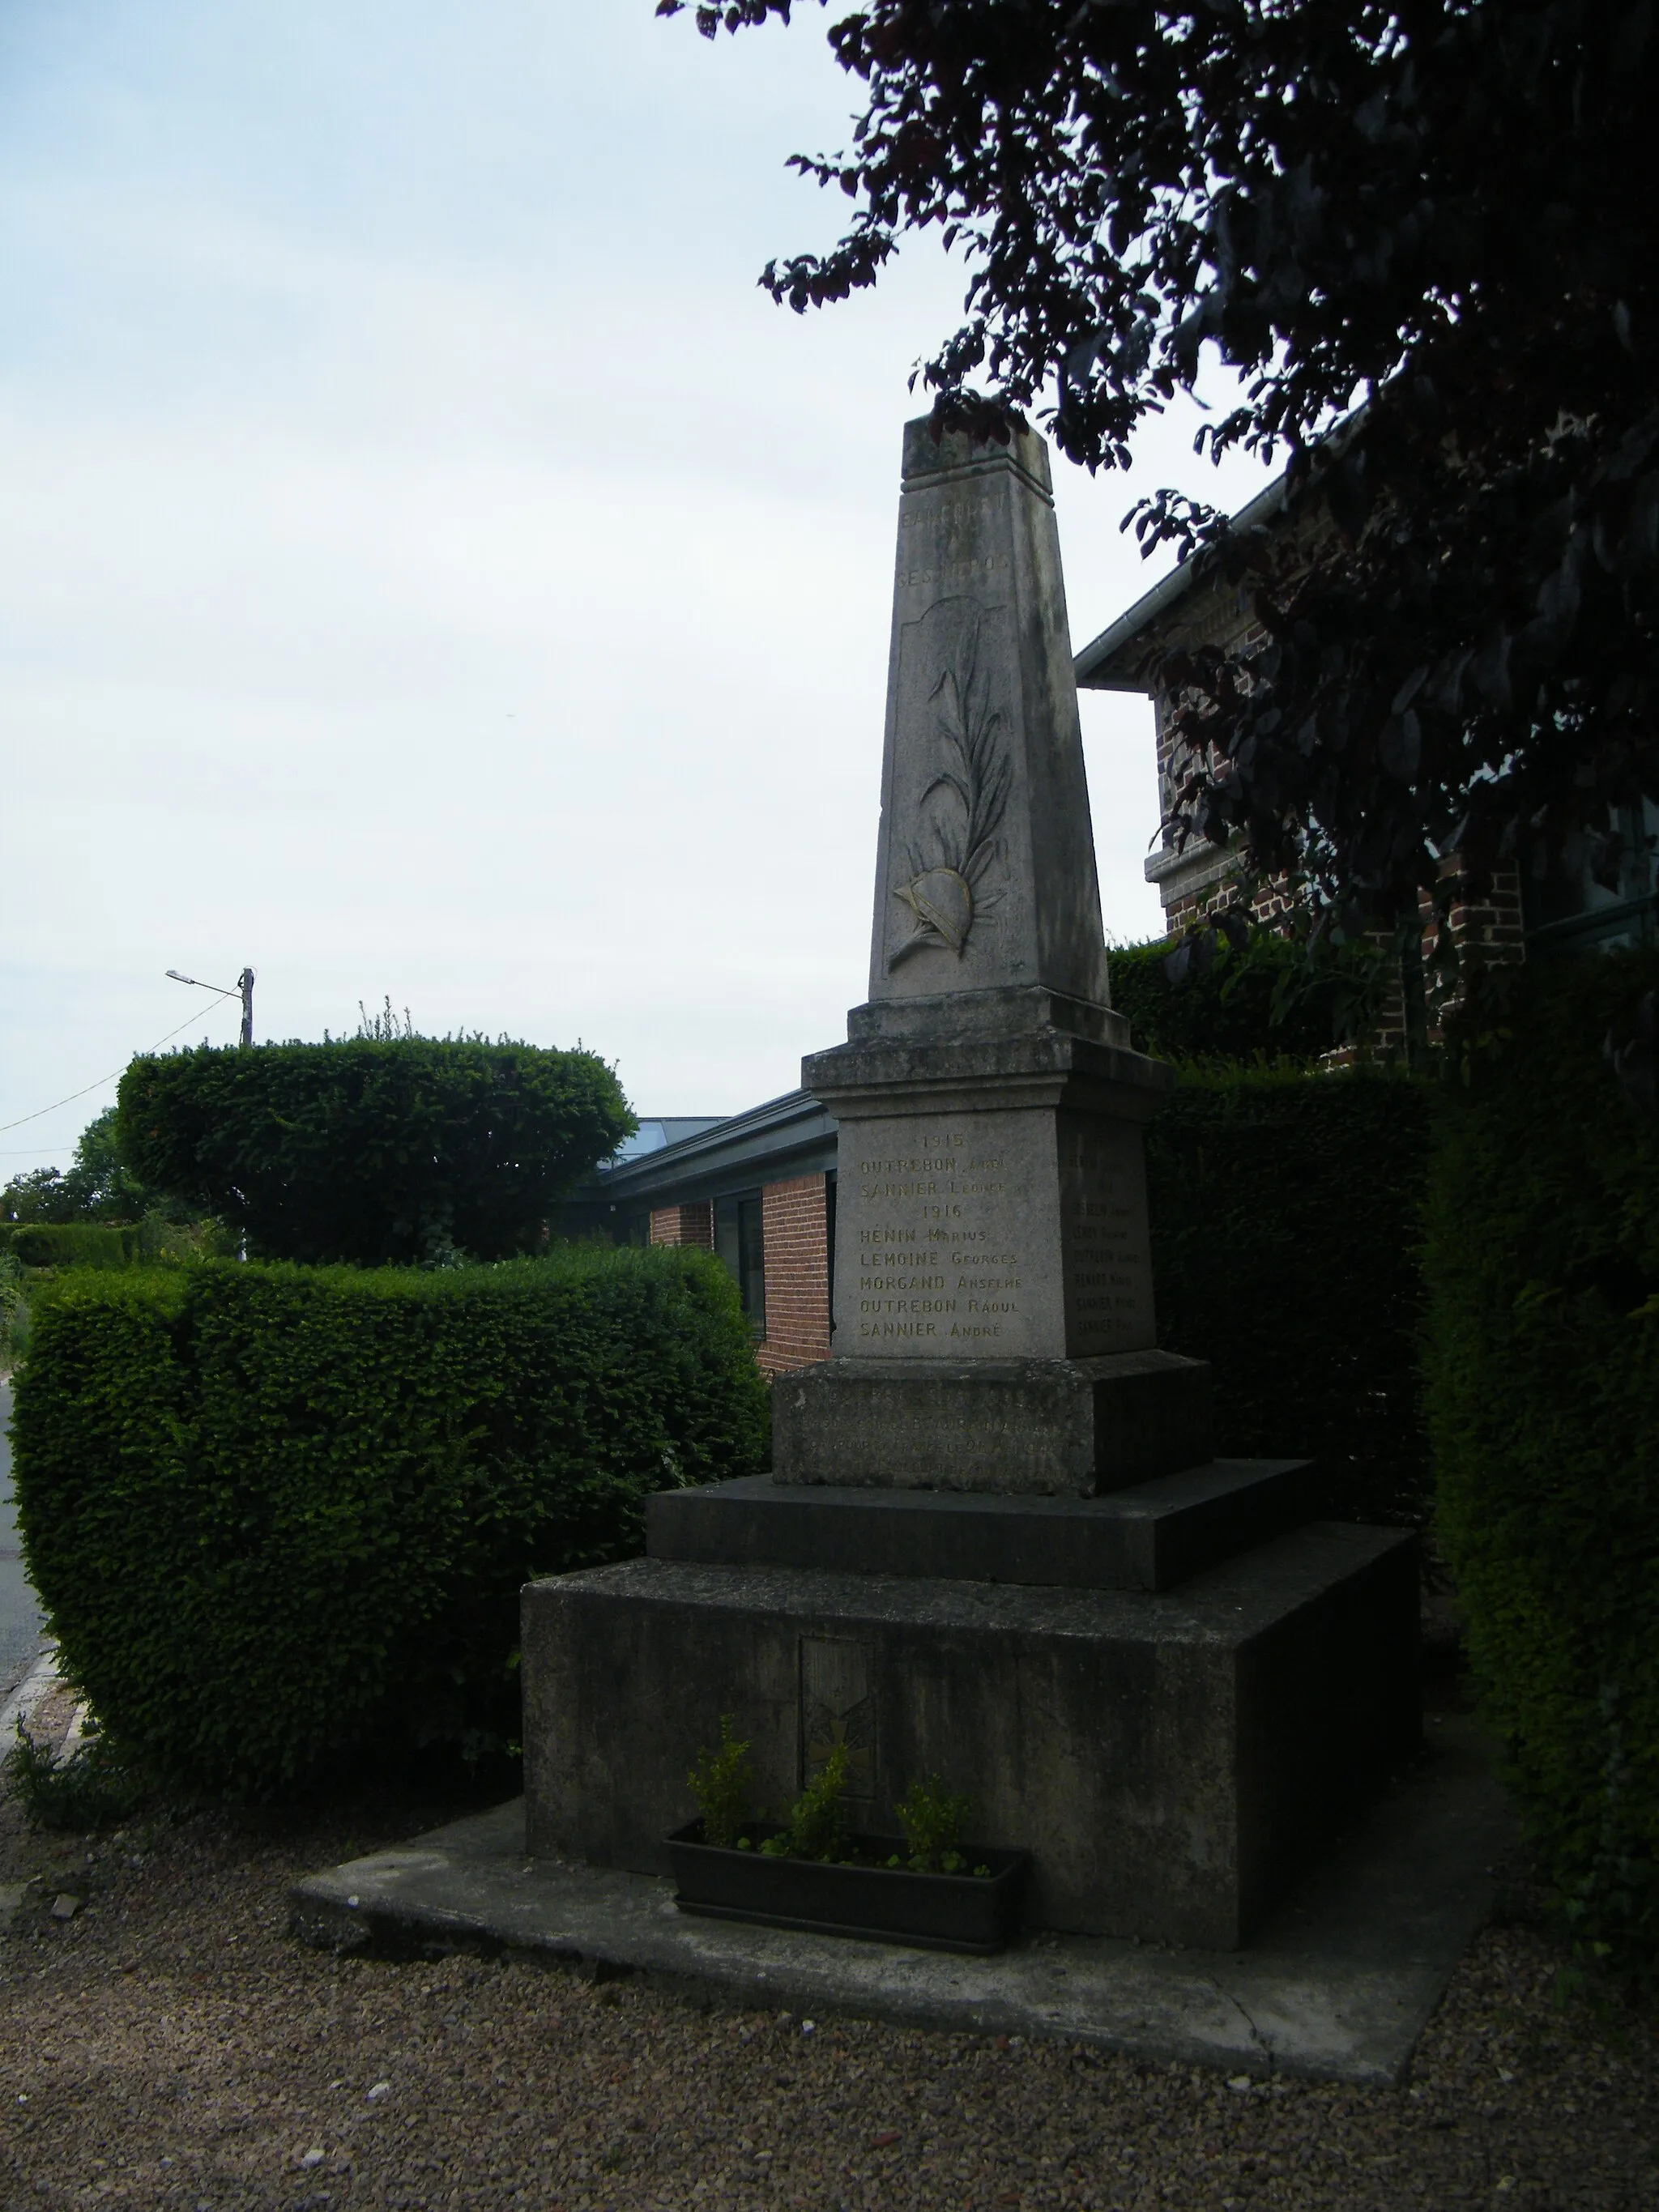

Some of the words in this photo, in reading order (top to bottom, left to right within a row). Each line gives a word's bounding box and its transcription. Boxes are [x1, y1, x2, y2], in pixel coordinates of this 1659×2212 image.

[923, 1134, 963, 1149] 1915
[861, 1157, 956, 1174] OUTREBON
[861, 1182, 937, 1200] SANNIER
[923, 1204, 962, 1219] 1916
[860, 1251, 939, 1267] LEMOINE
[859, 1276, 945, 1291] MORGAND
[860, 1299, 957, 1314] OUTREBON
[968, 1299, 1021, 1314] RAOUL
[860, 1323, 937, 1337] SANNIER
